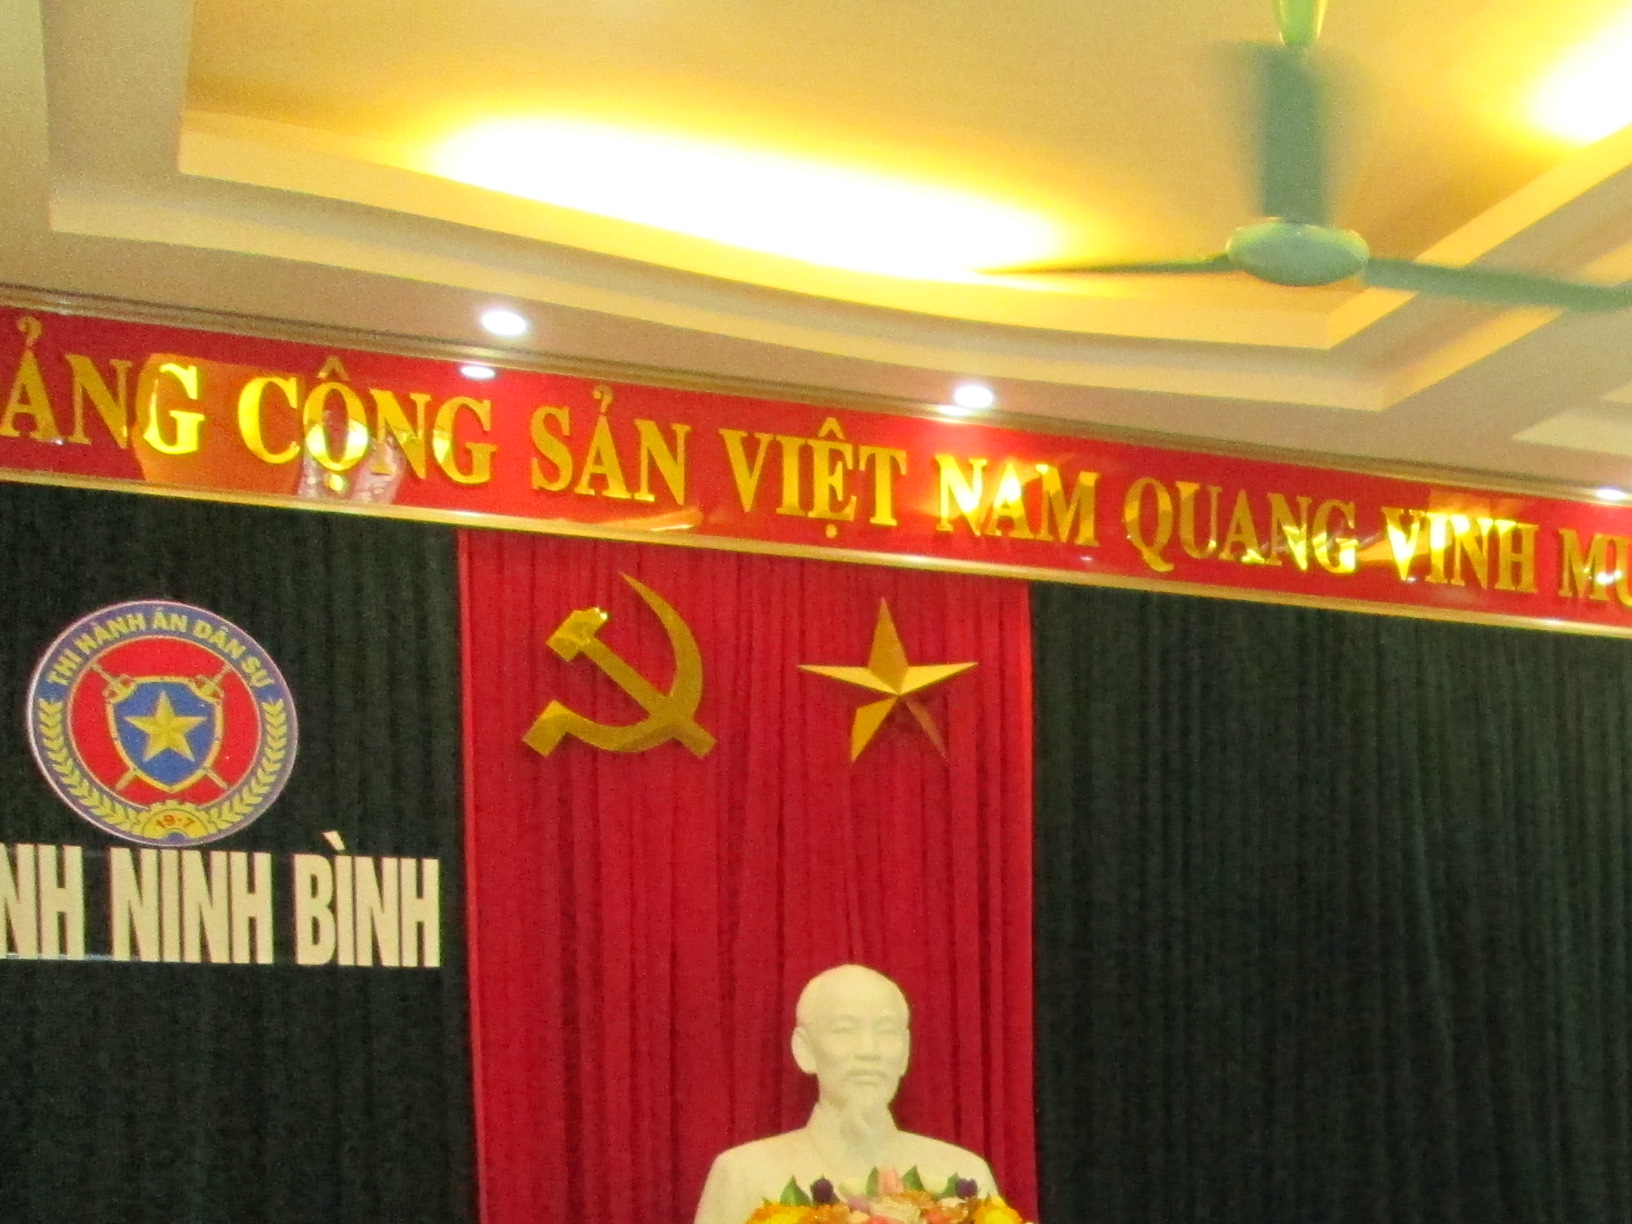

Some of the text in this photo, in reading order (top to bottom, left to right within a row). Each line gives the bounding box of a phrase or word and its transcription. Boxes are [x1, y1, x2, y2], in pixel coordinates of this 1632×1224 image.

[0, 316, 205, 456] ẢNG
[238, 356, 497, 491] CỘNG
[531, 386, 690, 505] SẢN
[719, 417, 907, 539] VIỆT
[933, 453, 1100, 547] NAM
[1122, 477, 1358, 574] QUANG
[1381, 506, 1539, 595] VINH
[47, 648, 83, 686] THI
[193, 620, 246, 659] DÂN
[109, 847, 274, 965] NINH
[293, 830, 440, 968] BÌNH
